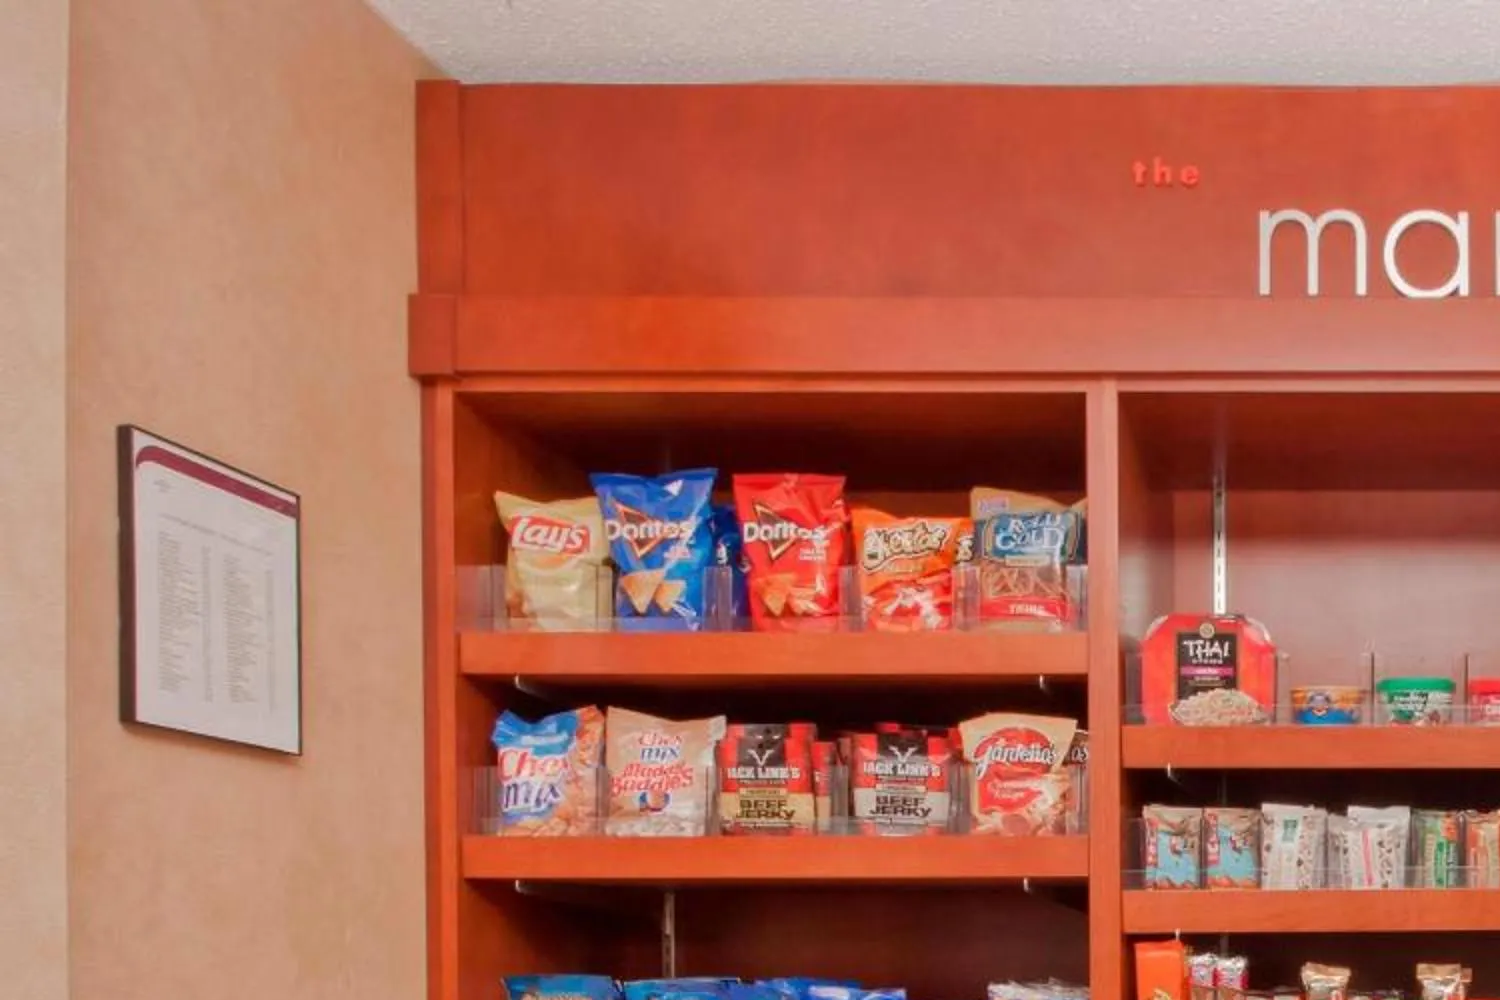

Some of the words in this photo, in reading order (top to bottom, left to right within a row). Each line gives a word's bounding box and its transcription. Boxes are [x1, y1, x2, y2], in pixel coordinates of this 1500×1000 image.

[1132, 159, 1200, 186] the
[510, 516, 587, 552] Lay's
[1182, 639, 1230, 659] THAI
[735, 808, 796, 821] JERKY
[869, 805, 933, 820] JERKY
